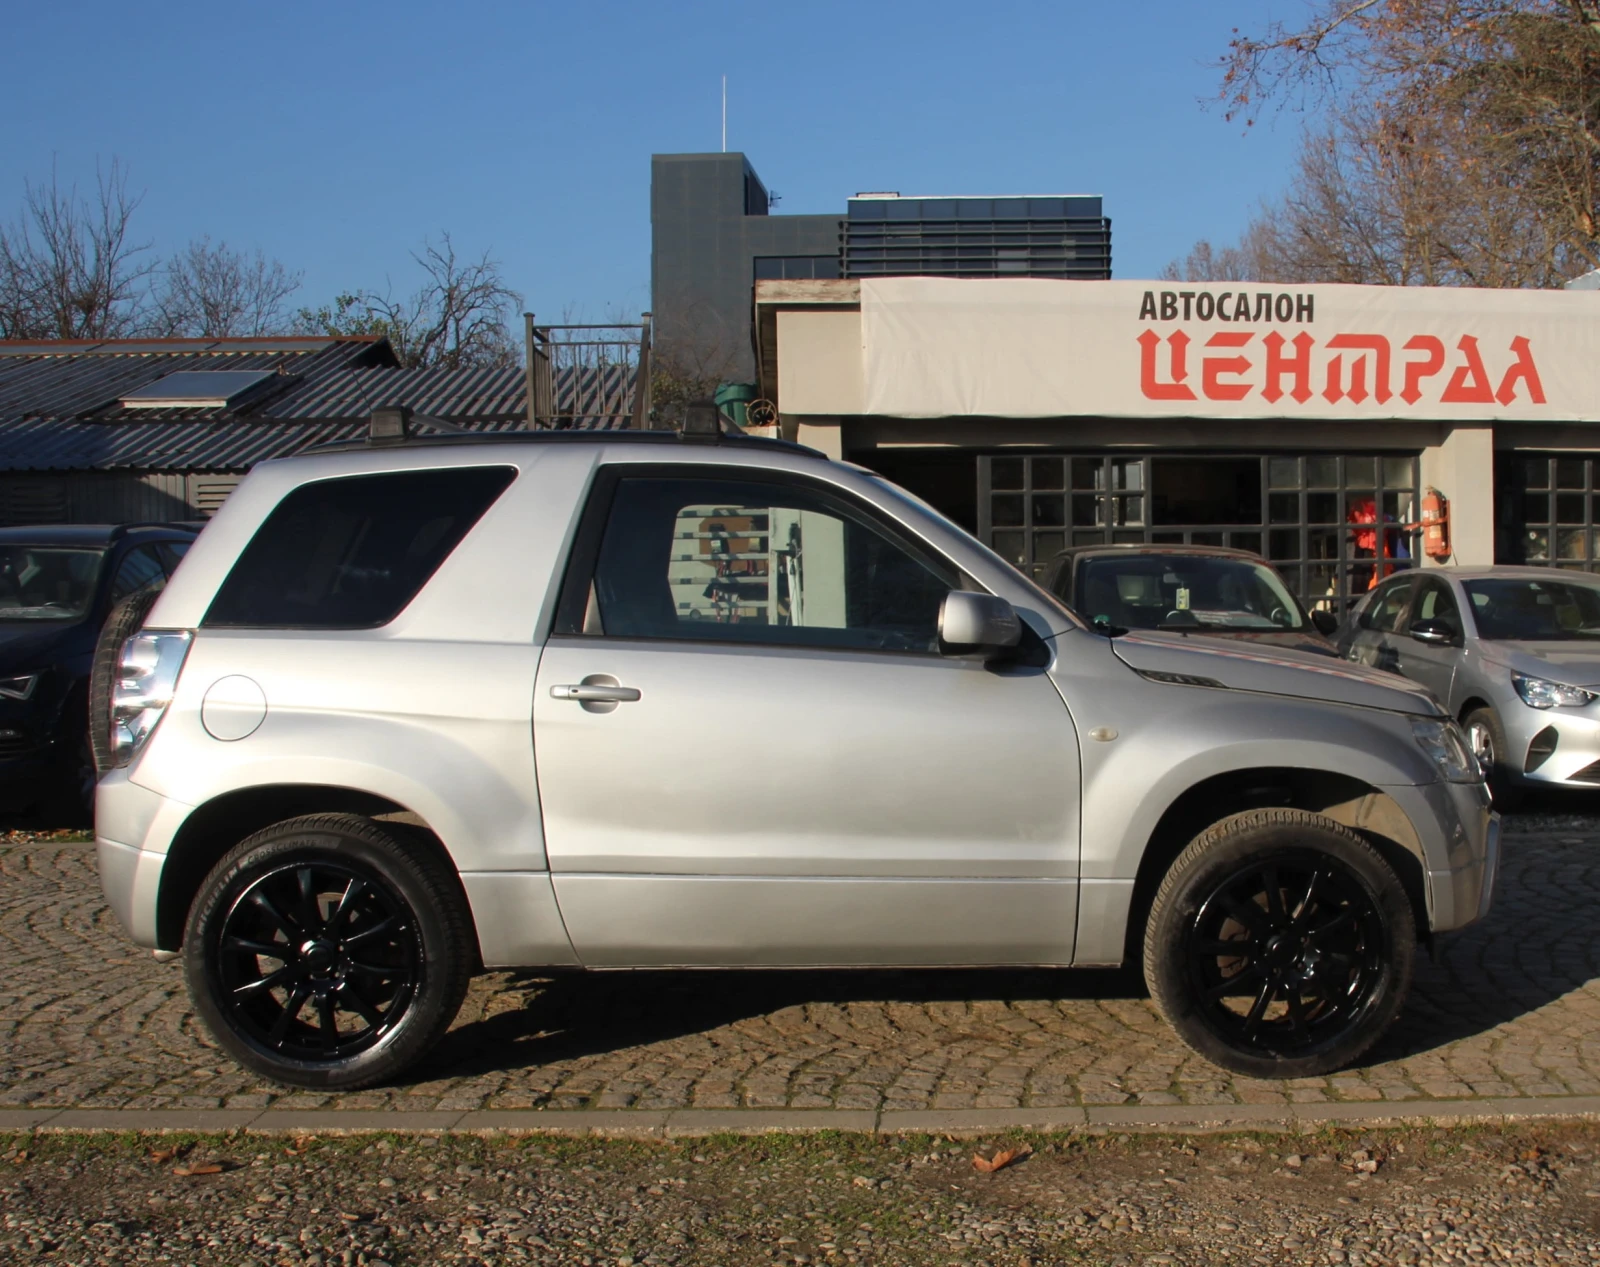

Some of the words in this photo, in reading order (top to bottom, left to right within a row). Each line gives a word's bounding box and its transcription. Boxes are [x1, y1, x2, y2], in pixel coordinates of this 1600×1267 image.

[1138, 291, 1314, 323] АВТОСАЛОН
[1136, 329, 1547, 407] ЦЕНТРАЛ
[196, 866, 239, 936] MICHELIN
